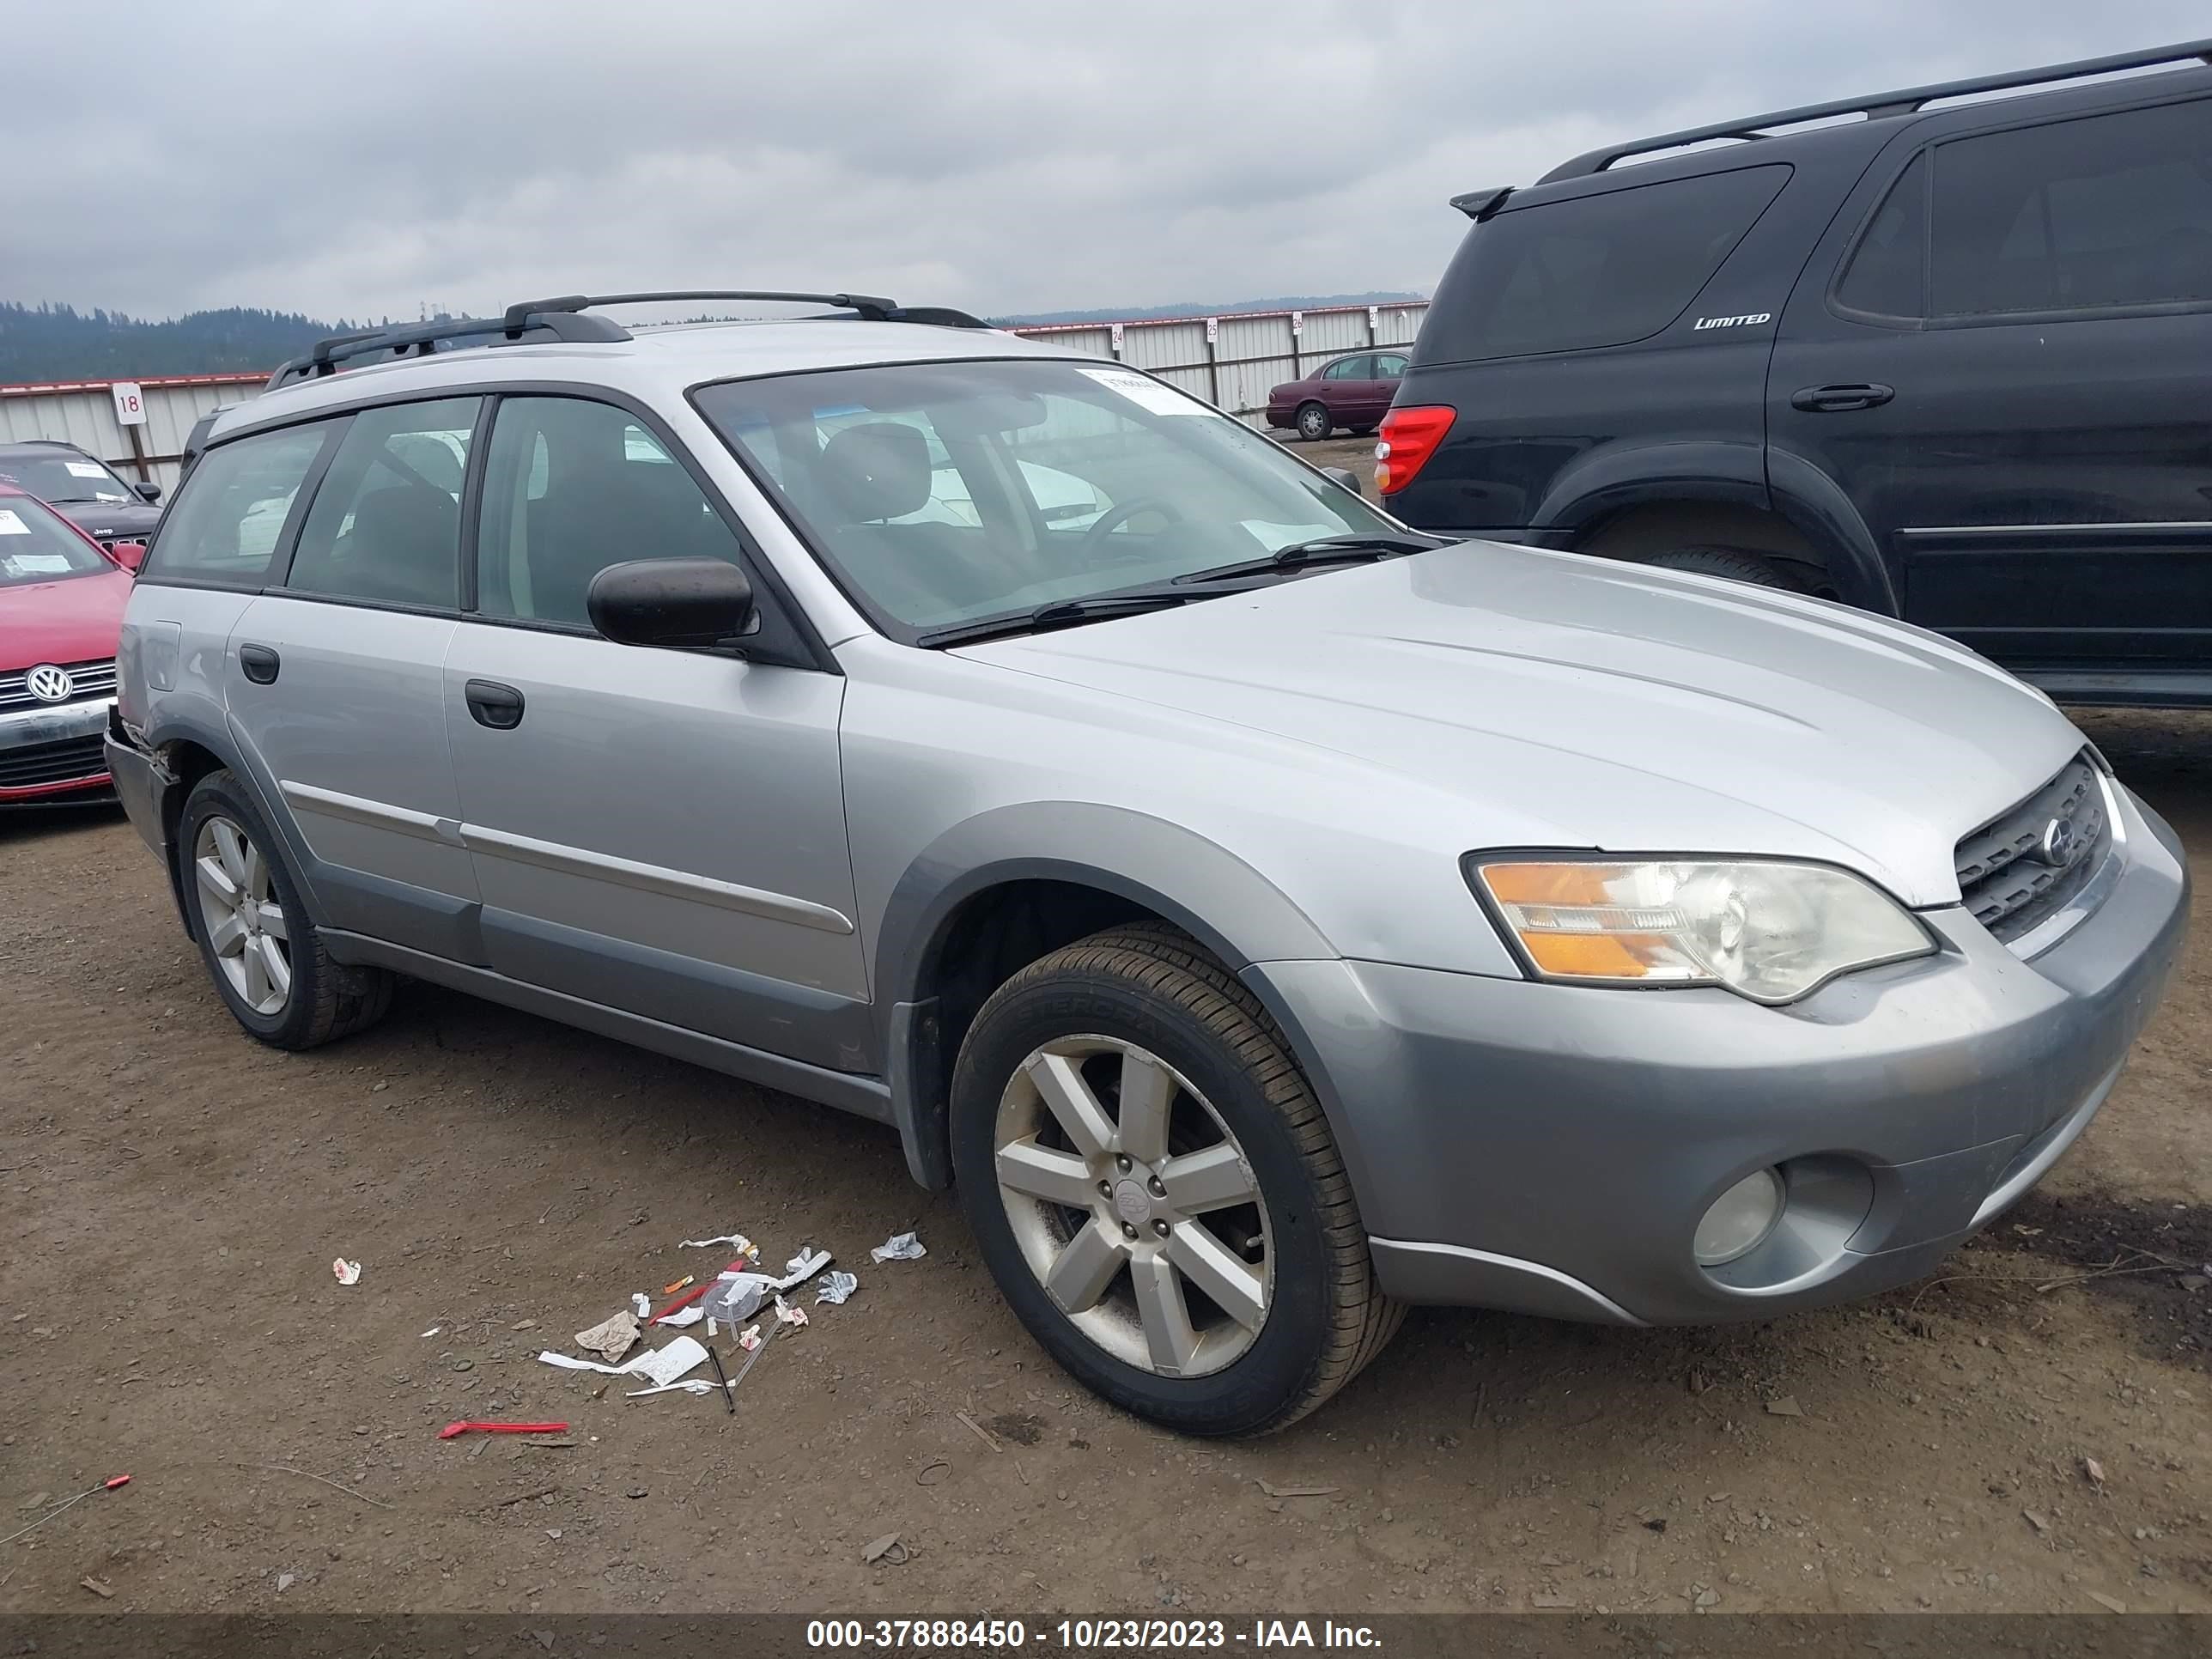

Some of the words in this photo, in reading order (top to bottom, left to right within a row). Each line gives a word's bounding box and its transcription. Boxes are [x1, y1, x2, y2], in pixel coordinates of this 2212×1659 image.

[1292, 318, 1303, 329] 26
[1694, 313, 1771, 331] LIMITED
[1209, 325, 1217, 336] 25
[1114, 331, 1122, 343] 24
[120, 396, 138, 412] 18
